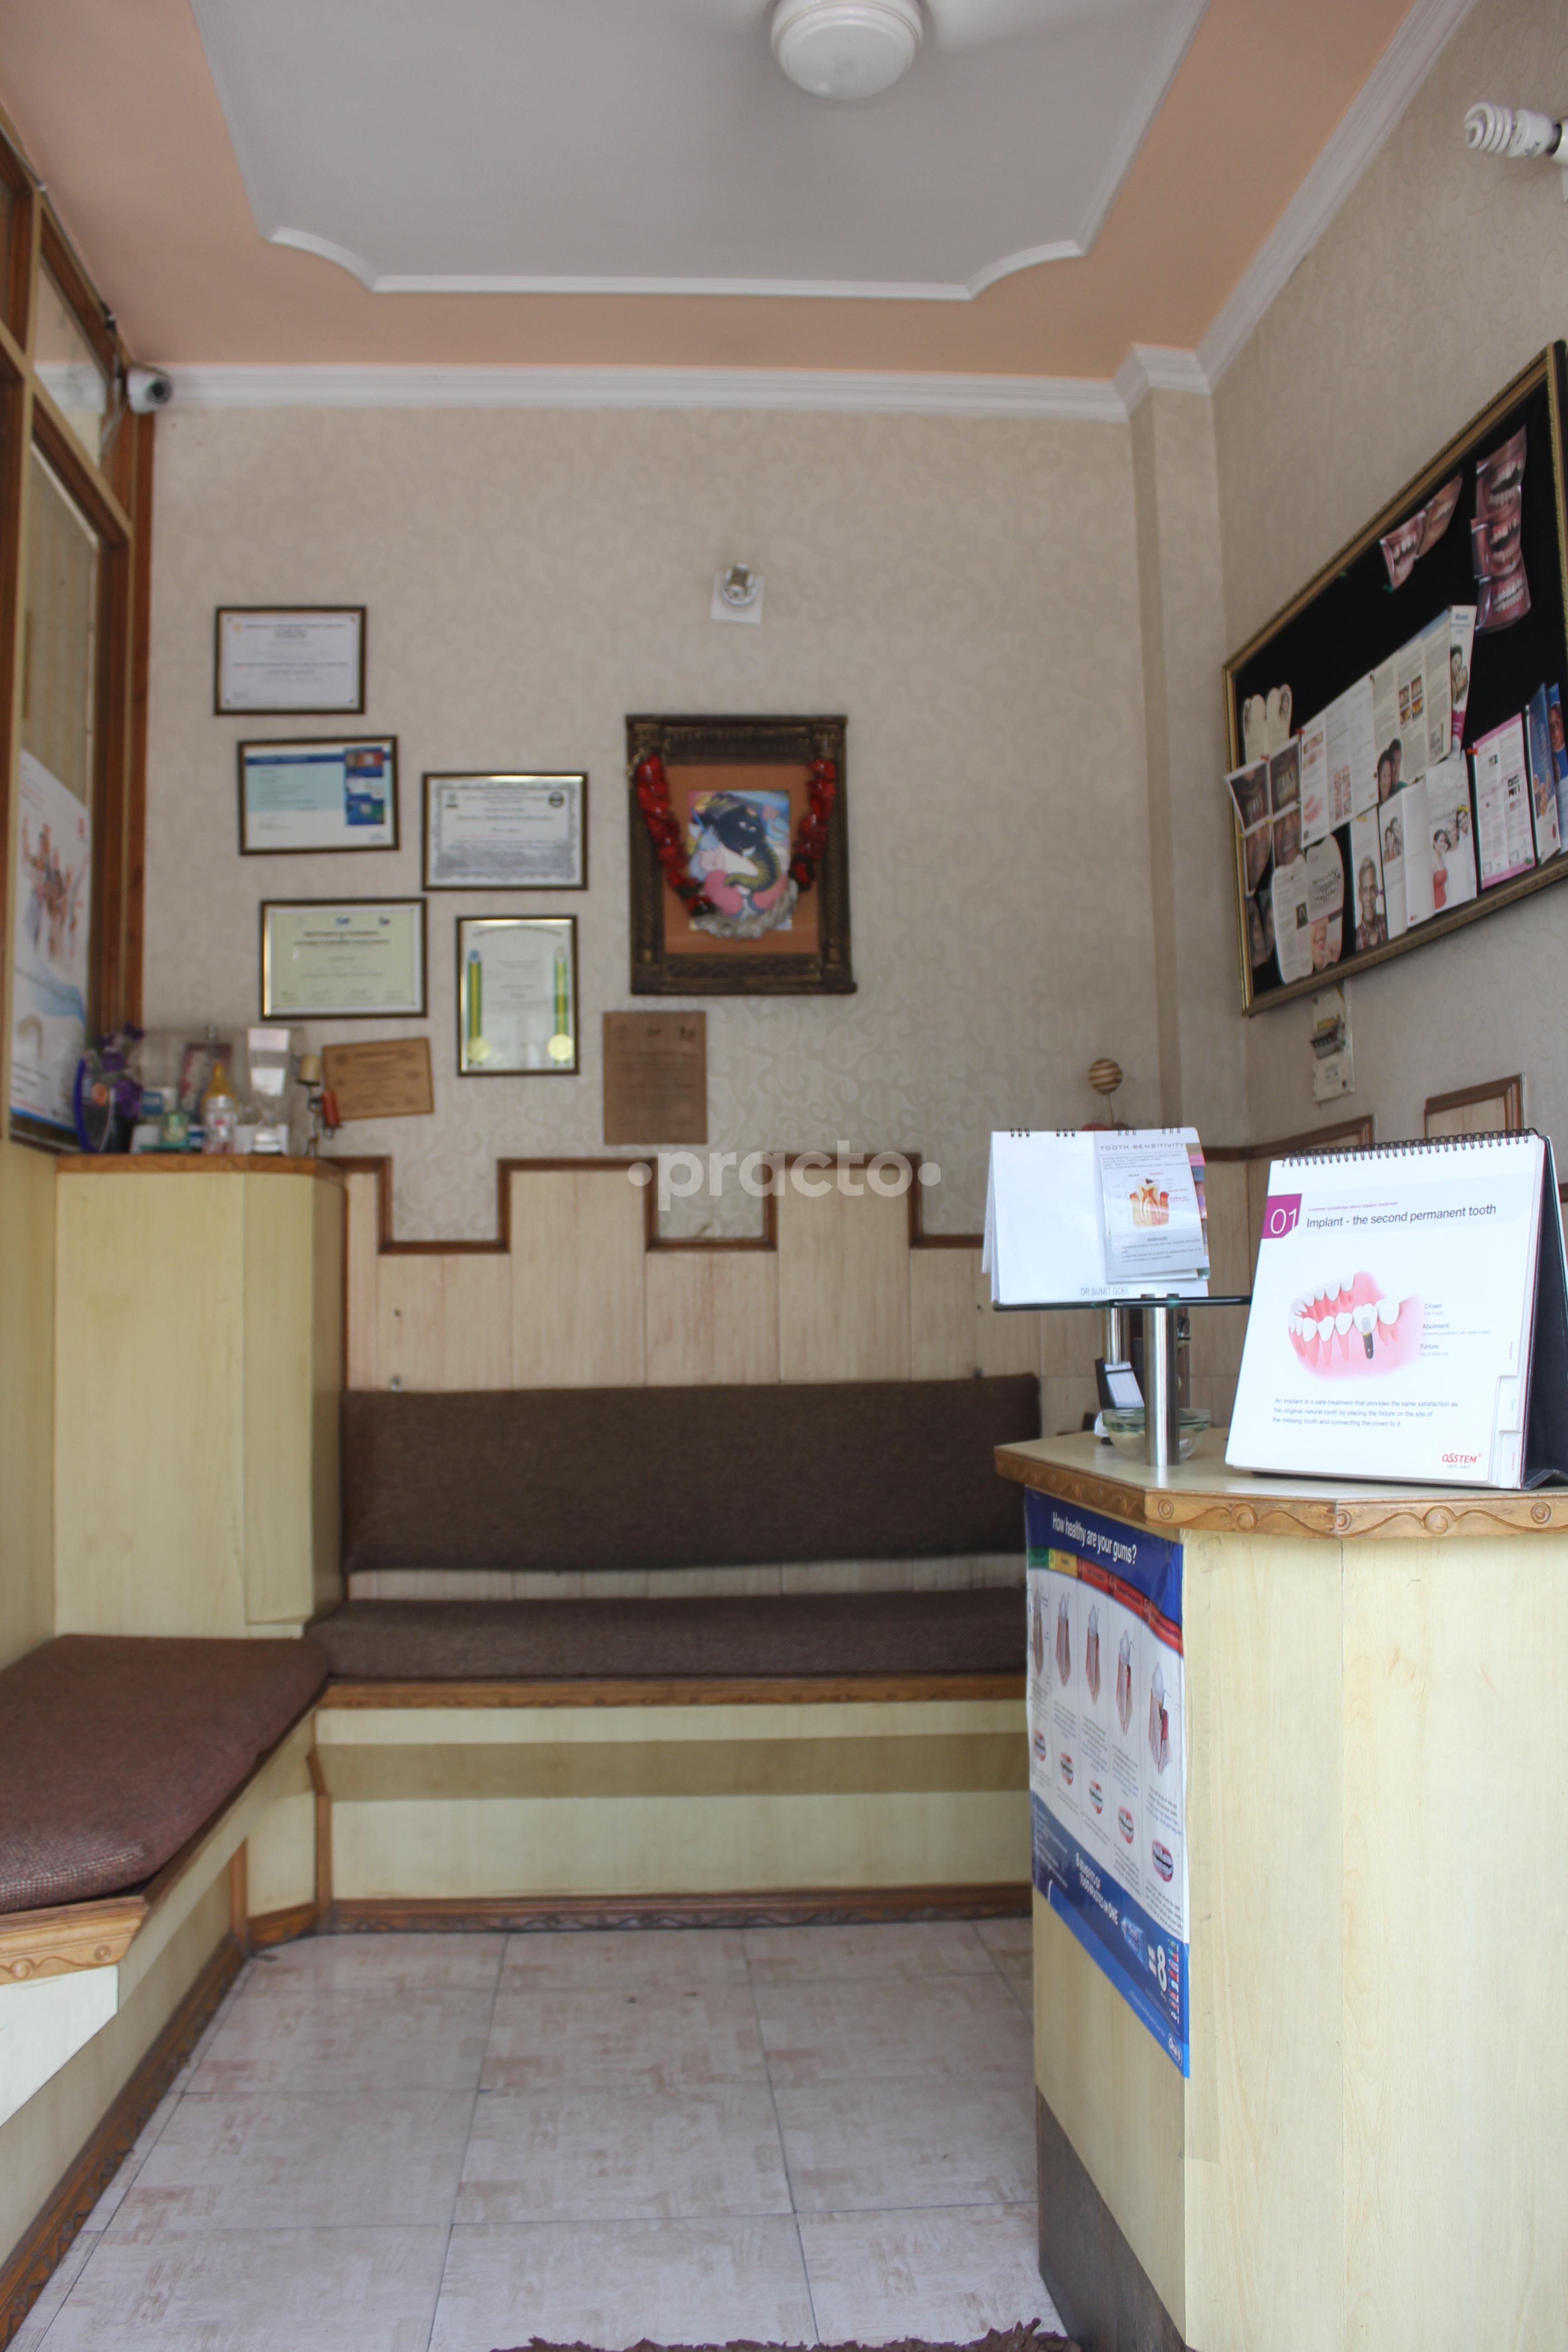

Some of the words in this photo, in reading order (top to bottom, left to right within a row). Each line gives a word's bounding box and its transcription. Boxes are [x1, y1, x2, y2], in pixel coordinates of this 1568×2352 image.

[1270, 1208, 1298, 1234] 01
[1306, 1216, 1343, 1229] Implant
[1352, 1215, 1368, 1225] the
[1370, 1211, 1408, 1224] second
[1410, 1207, 1466, 1223] permanent
[1469, 1204, 1496, 1216] tooth
[1112, 1286, 1129, 1295] GOEL
[1442, 1453, 1477, 1463] OSSTEM
[1053, 1511, 1065, 1534] How
[1066, 1516, 1086, 1547] healthy
[1087, 1530, 1097, 1548] are
[1097, 1534, 1112, 1554] your
[1113, 1541, 1137, 1565] gums?
[1157, 1945, 1167, 1992] 8
